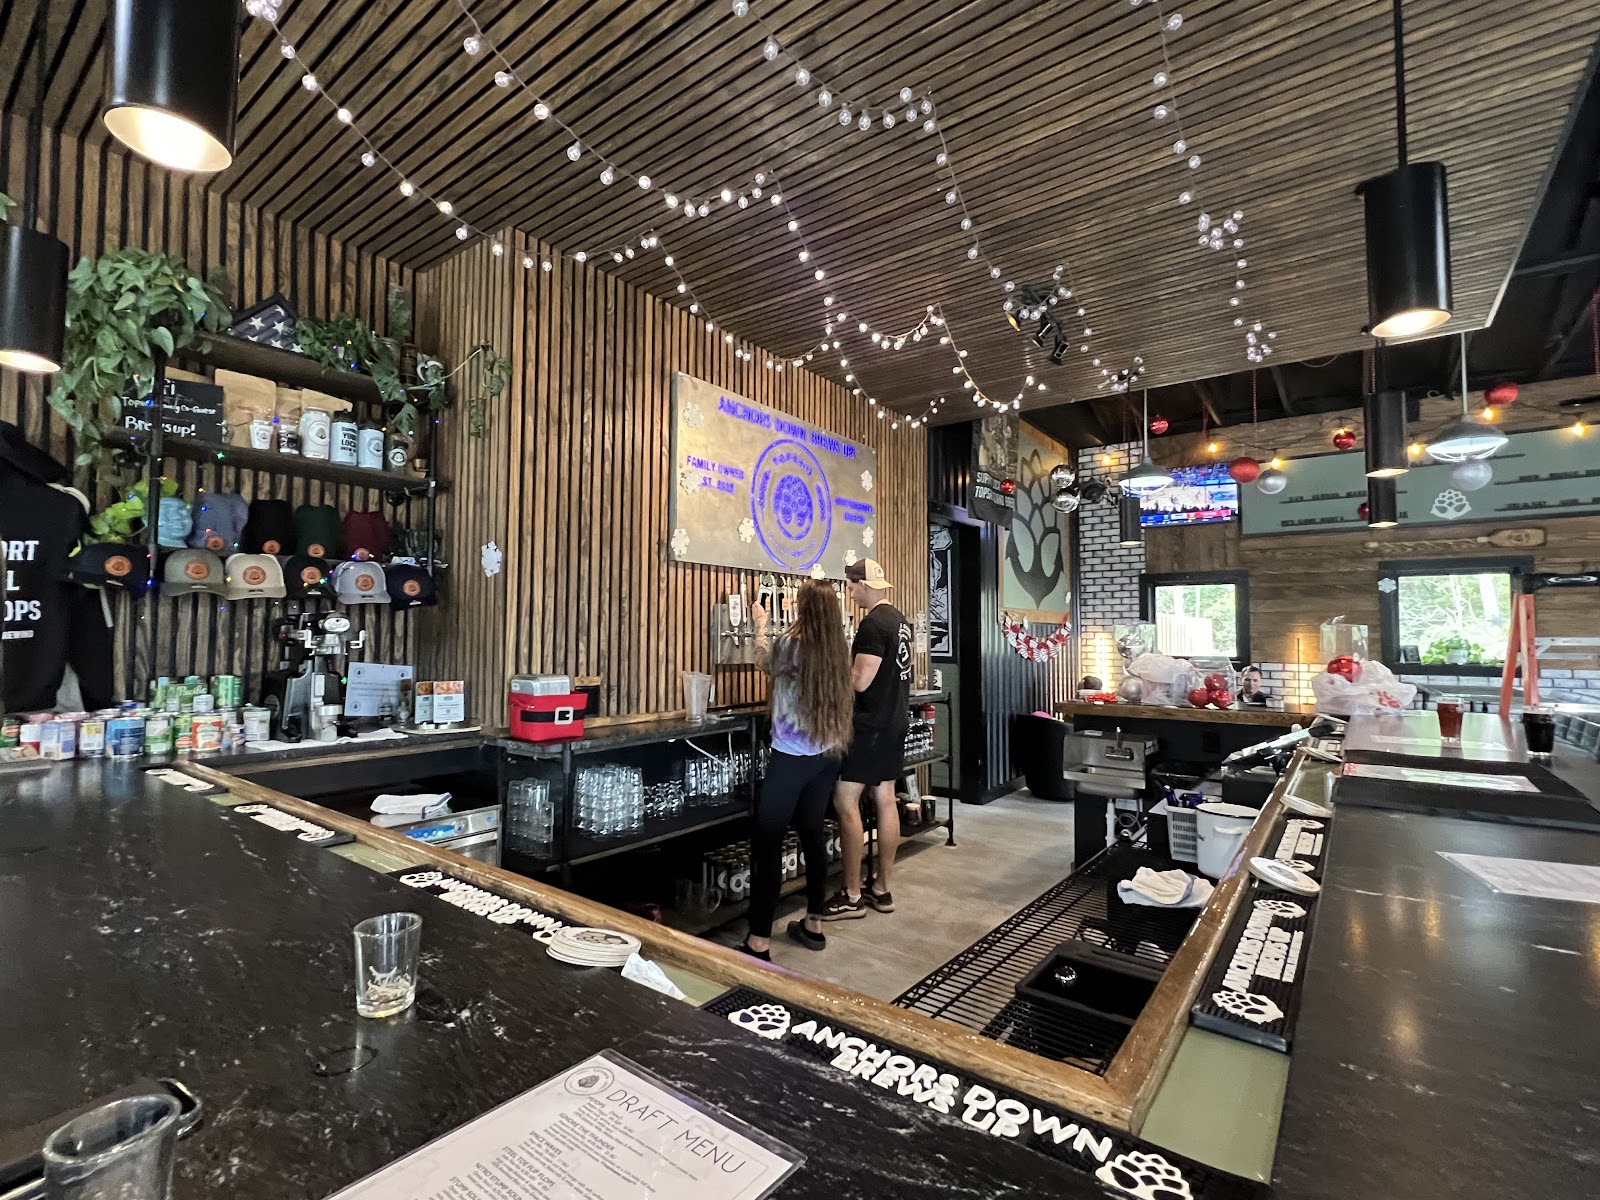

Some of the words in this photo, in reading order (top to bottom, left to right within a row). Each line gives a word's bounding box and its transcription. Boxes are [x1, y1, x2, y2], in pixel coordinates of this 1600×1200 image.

[718, 396, 771, 429] ANCHORS
[775, 418, 806, 441] DOWN
[810, 431, 840, 454] BREWS
[687, 455, 715, 471] FAMILY
[718, 464, 744, 480] OWNED
[6, 570, 20, 591] L
[791, 1020, 960, 1093] ANCHORS
[961, 1084, 1113, 1162] DOWN
[830, 1048, 955, 1114] BREWS
[501, 1146, 518, 1158] STEEL
[606, 1089, 679, 1130] DRAFT
[674, 1129, 746, 1173] MENU
